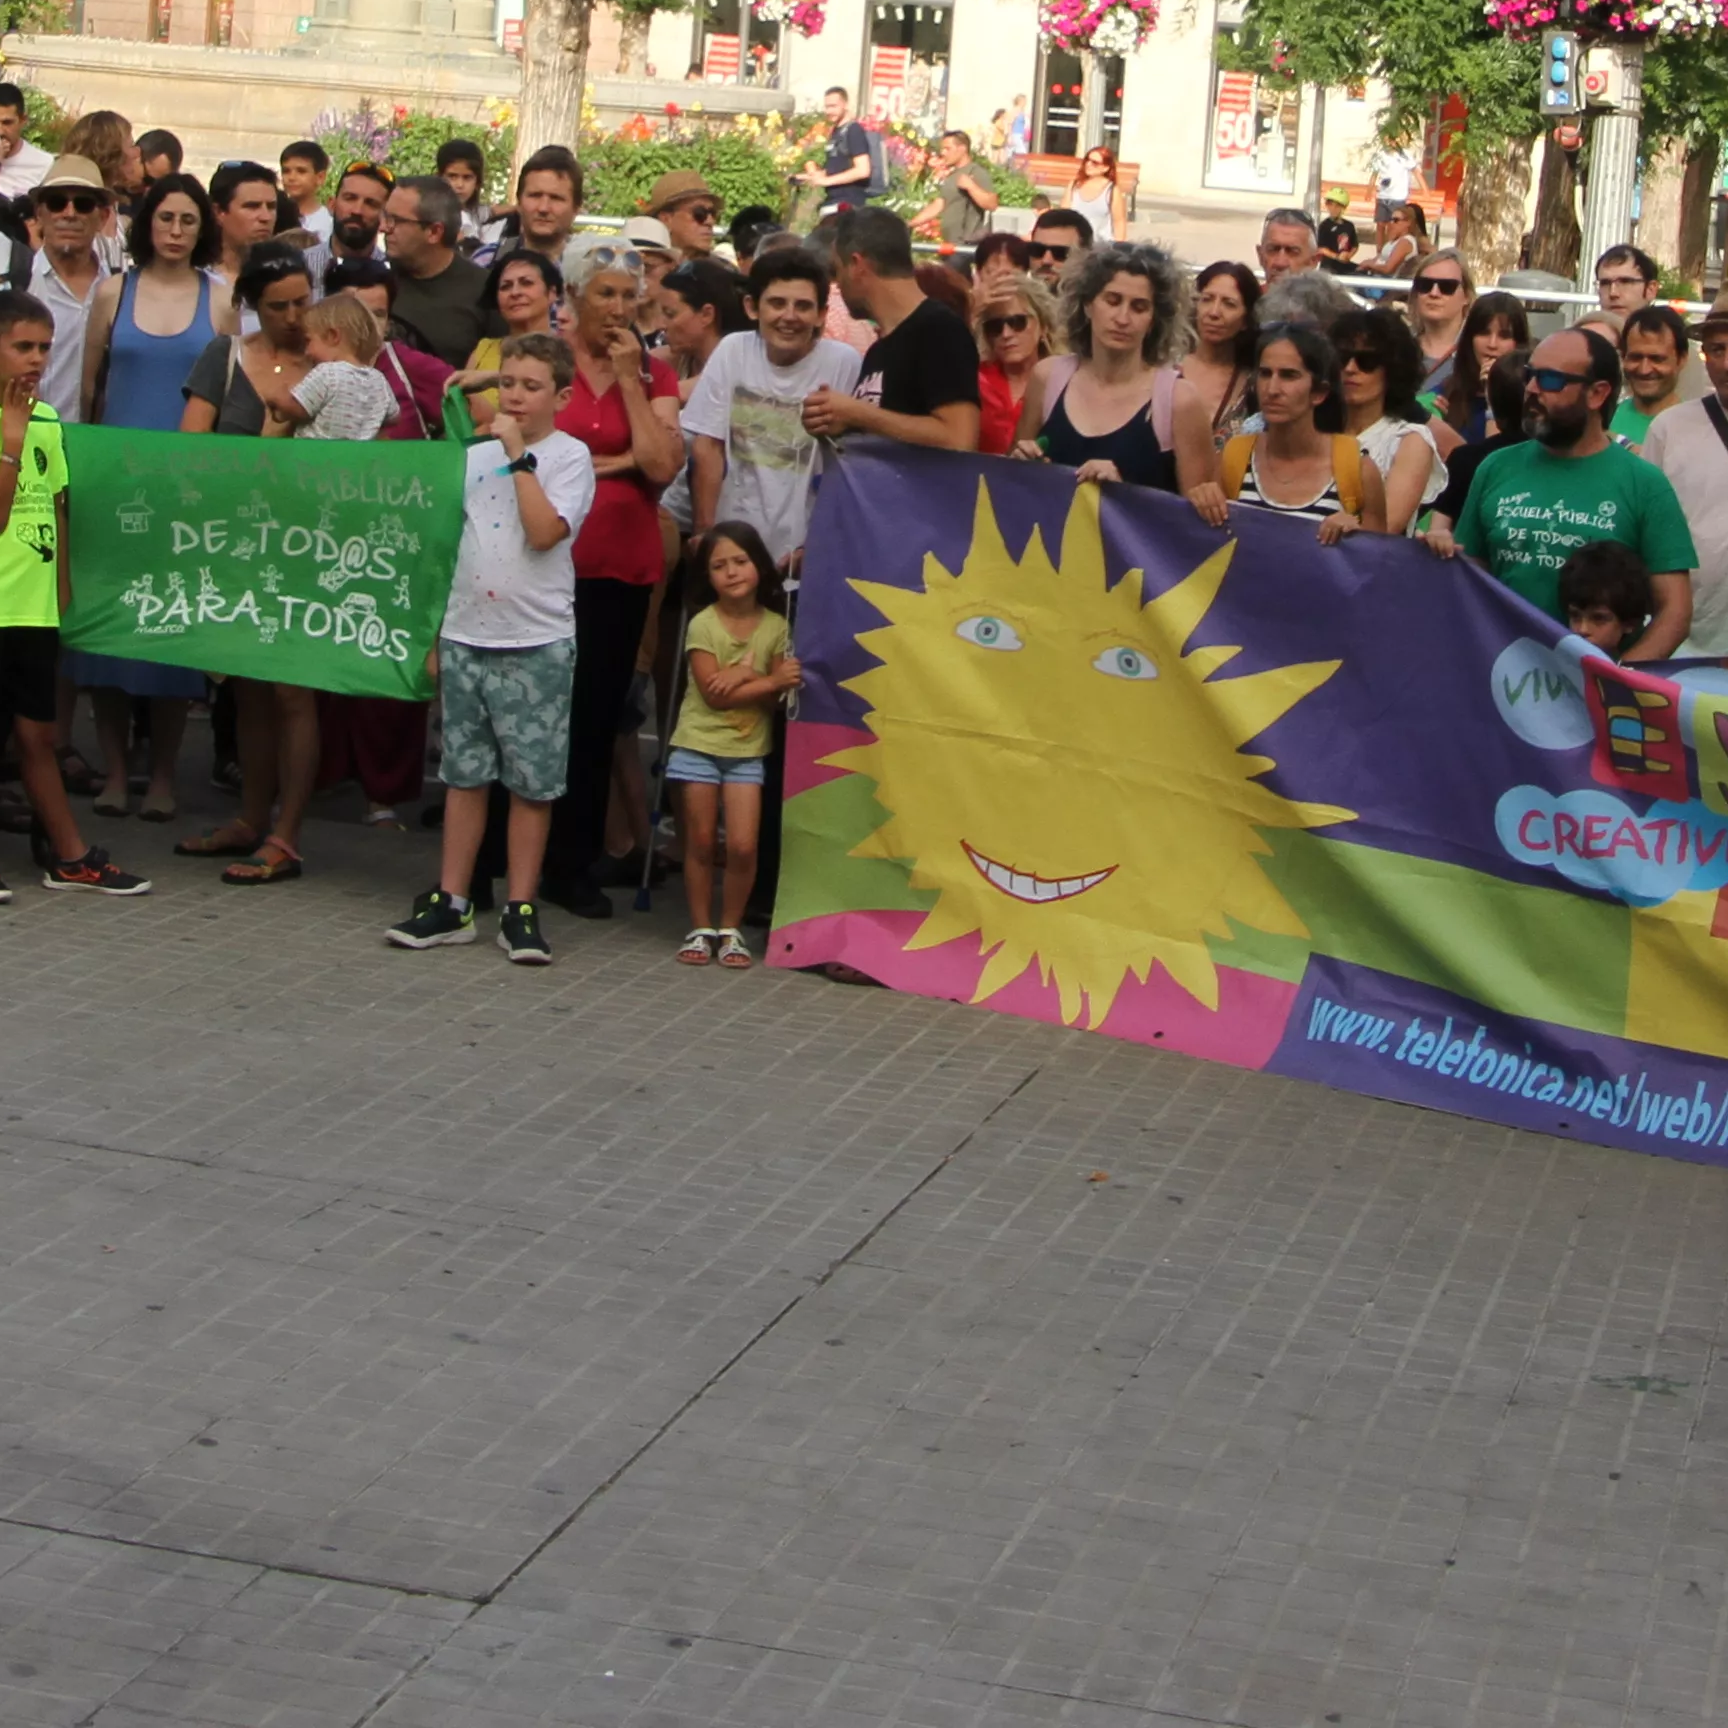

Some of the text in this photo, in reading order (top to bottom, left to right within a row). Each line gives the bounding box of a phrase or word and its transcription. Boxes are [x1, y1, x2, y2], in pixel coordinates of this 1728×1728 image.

[872, 85, 905, 122] 50
[1215, 113, 1253, 151] 50
[1495, 505, 1616, 532] ESCUELA PÚBLICA
[1507, 527, 1528, 540] DE
[172, 519, 397, 580] DE TOD@S
[1536, 554, 1567, 570] TOD
[136, 589, 412, 663] PARA TOD@S
